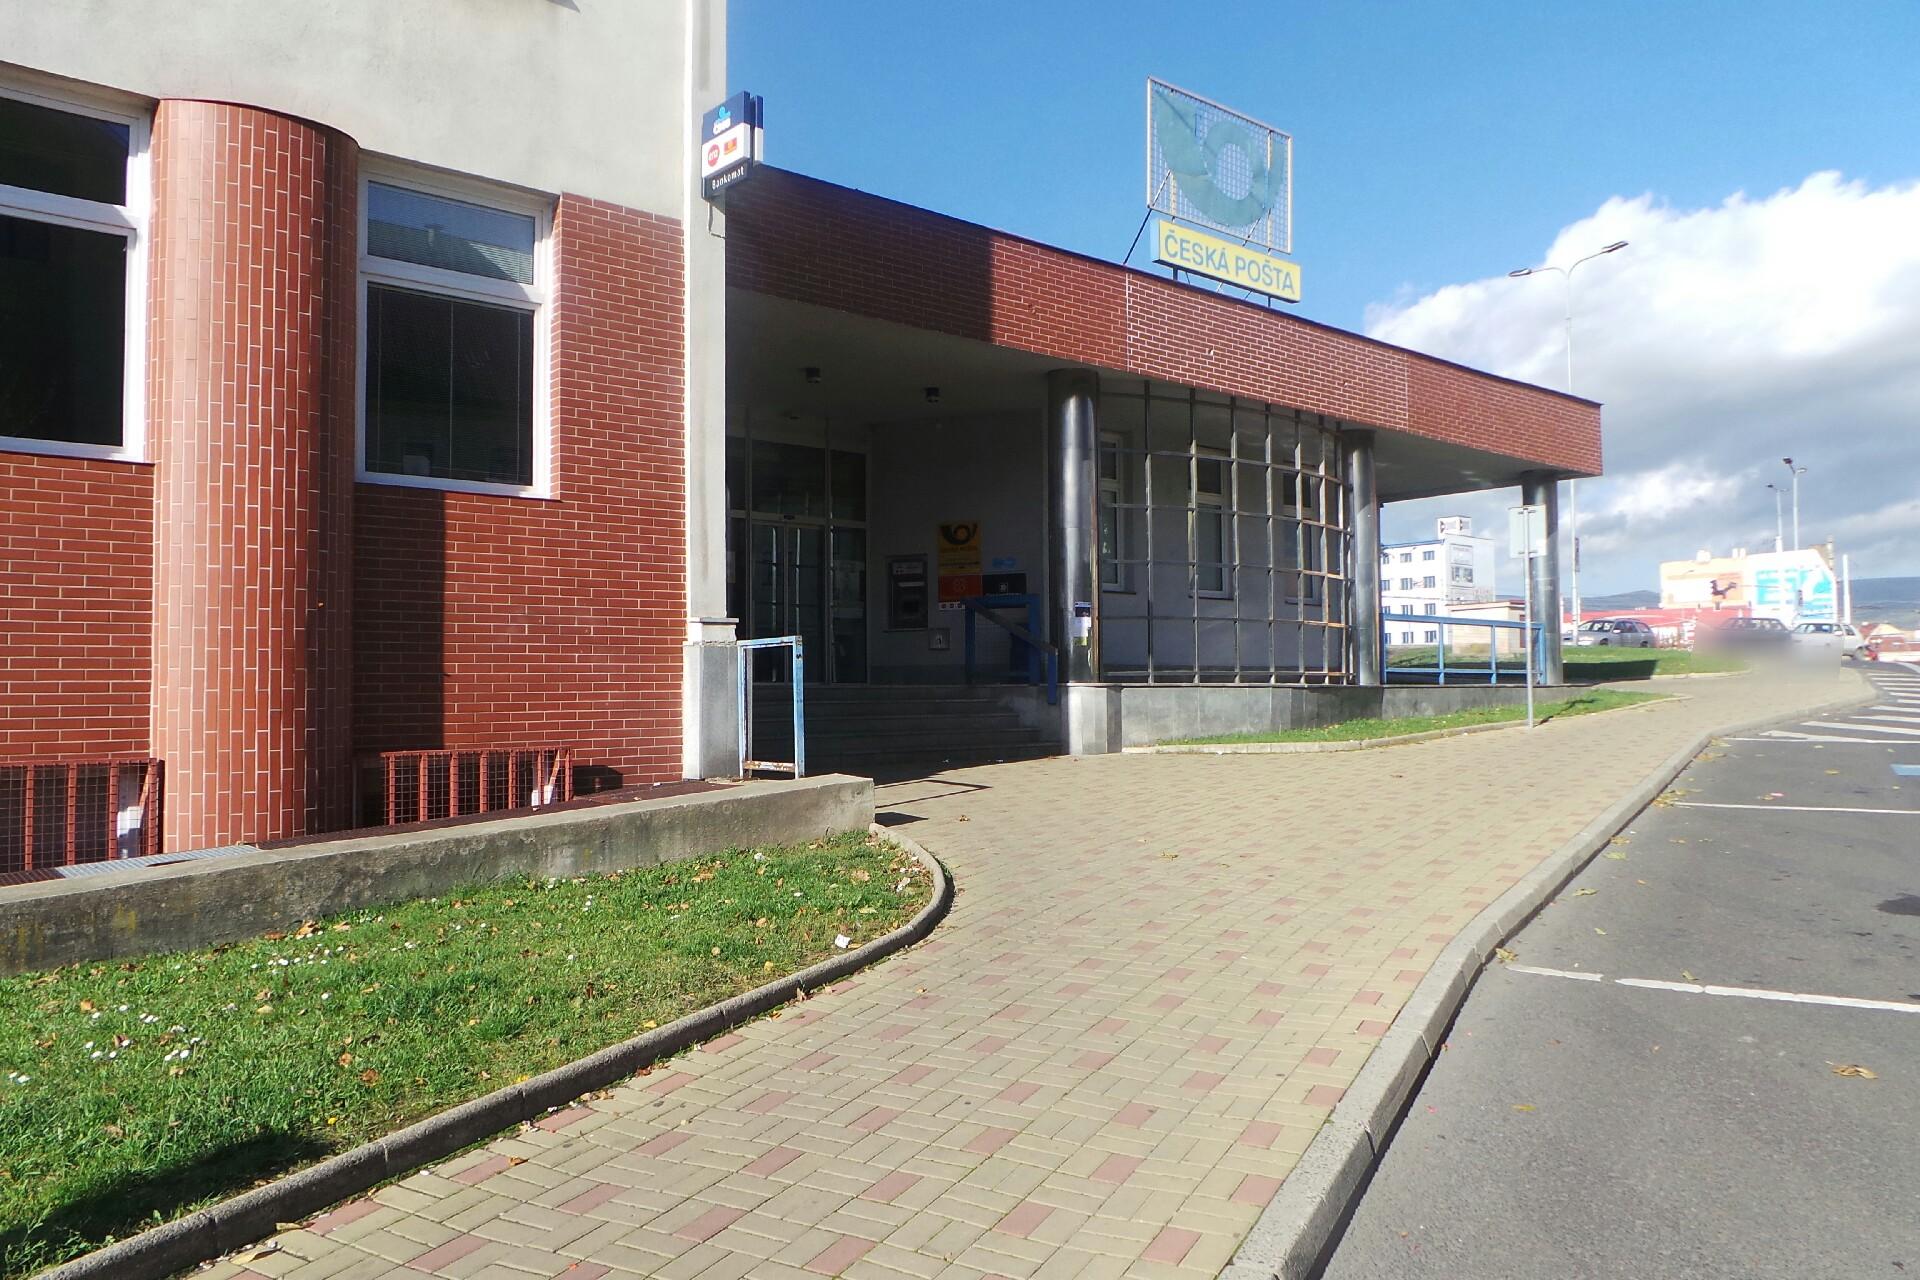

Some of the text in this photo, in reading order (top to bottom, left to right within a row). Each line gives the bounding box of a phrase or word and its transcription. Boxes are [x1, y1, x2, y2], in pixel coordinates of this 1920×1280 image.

[712, 166, 744, 190] Bankomat
[1164, 230, 1294, 293] ČESKÁ POŠTA
